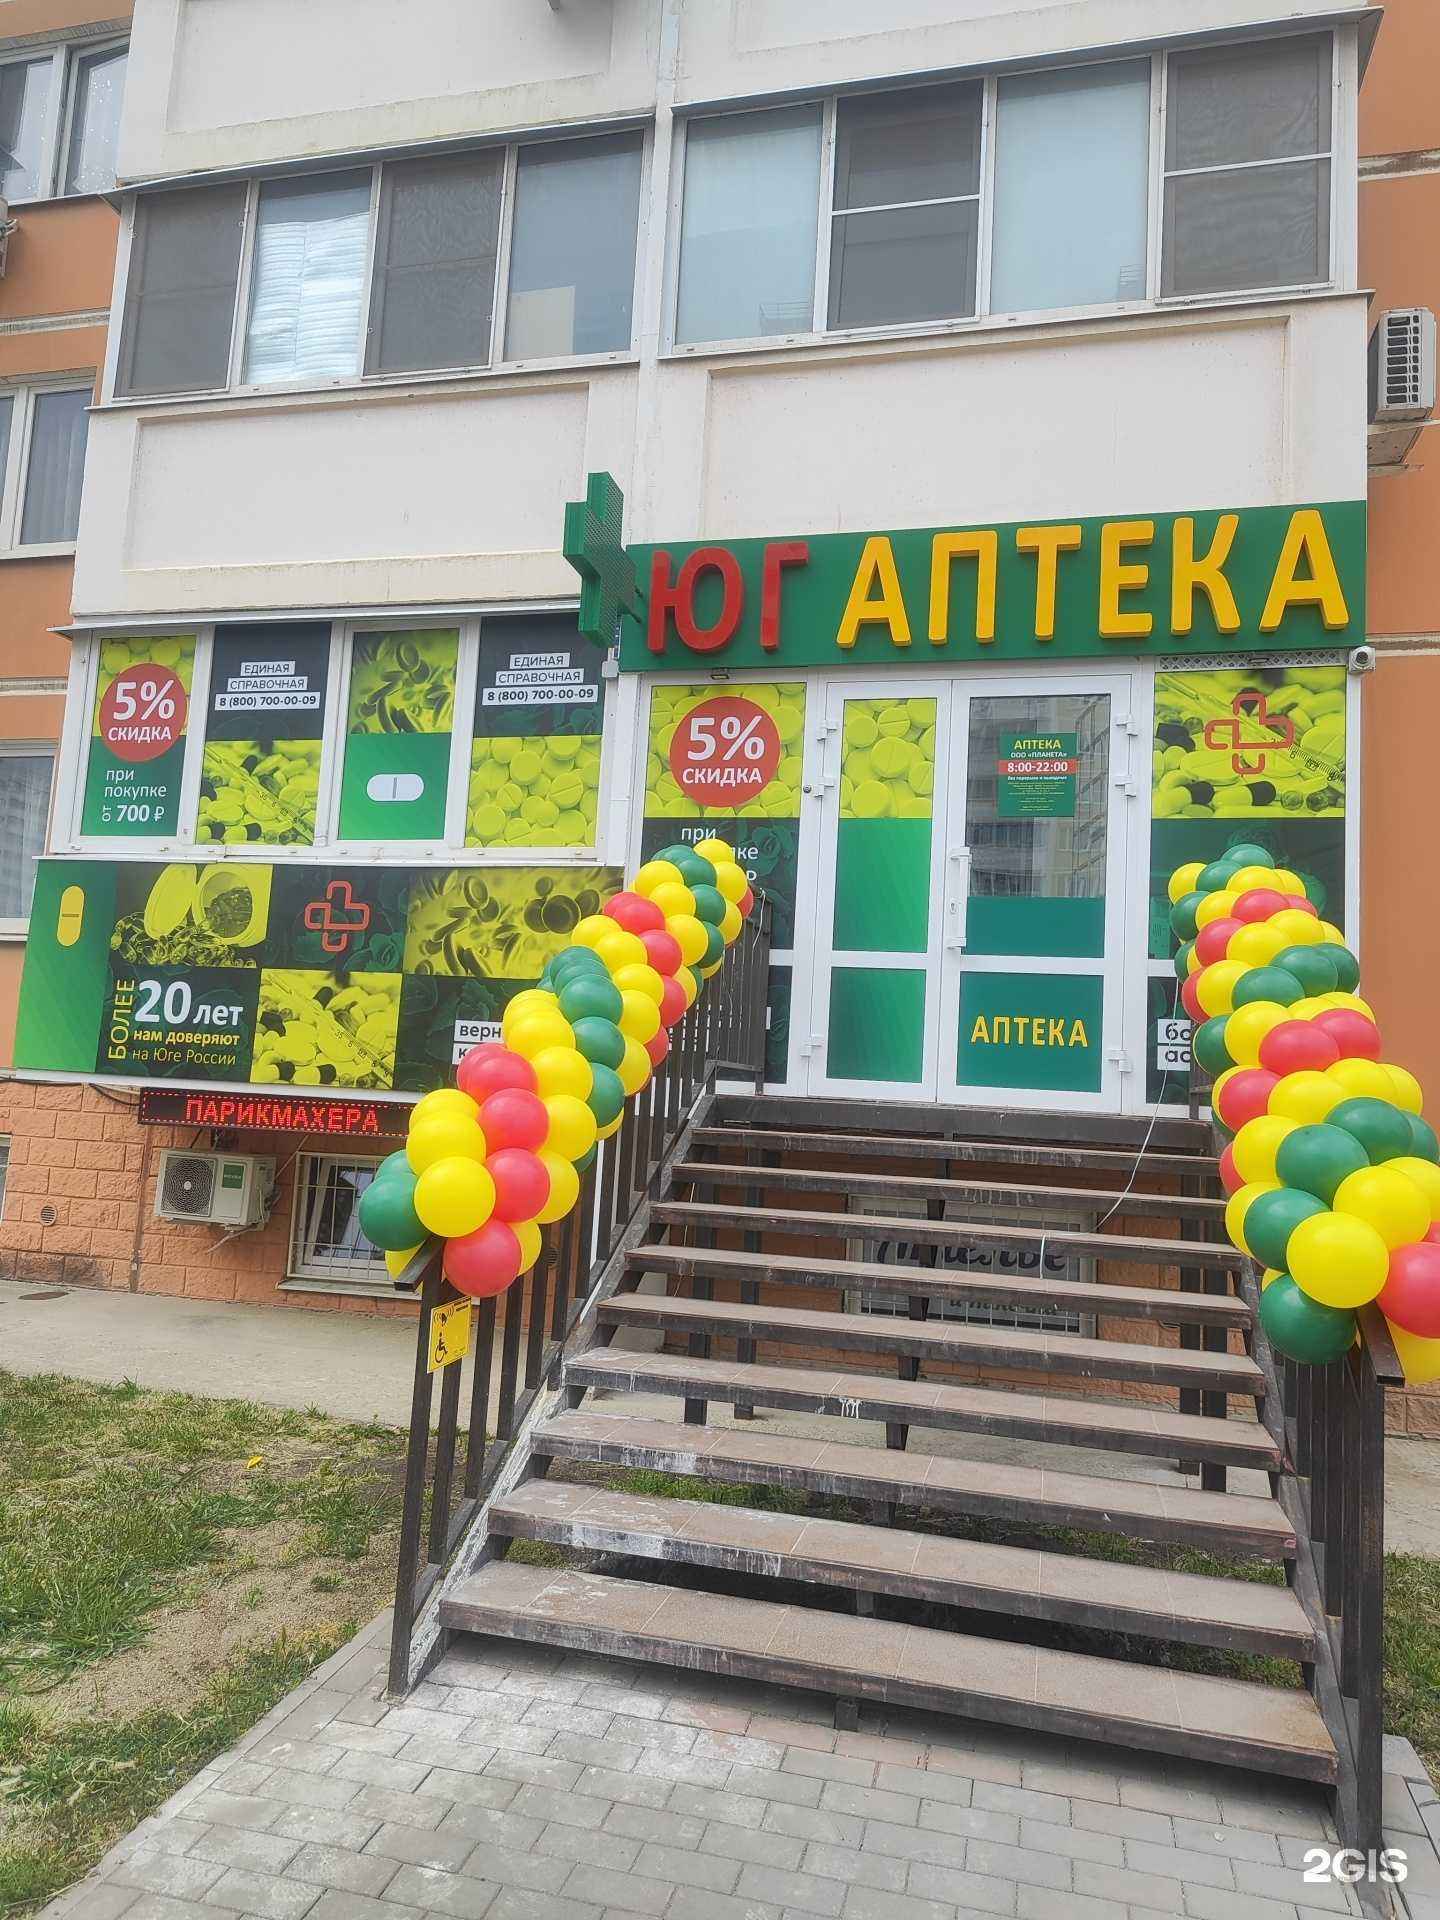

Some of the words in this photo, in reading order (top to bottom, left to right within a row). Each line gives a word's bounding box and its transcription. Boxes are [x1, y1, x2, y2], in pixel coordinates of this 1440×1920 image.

[647, 537, 809, 654] ЮГ
[836, 509, 1350, 648] АПТЕКА
[244, 664, 290, 674] ЕДИНАЯ
[514, 655, 564, 667] ЕДИНАЯ
[230, 679, 305, 690] СПРАВОЧНАЯ
[498, 671, 580, 683] СПРАВОЧНАЯ
[113, 679, 176, 721] 5%
[219, 698, 226, 706] 8
[229, 696, 257, 707] (800)
[260, 694, 316, 706] 700-00-09
[487, 691, 495, 701] 8
[498, 690, 529, 702] (800)
[532, 688, 594, 700] 700-00-09
[108, 726, 172, 742] СКИДКА
[687, 715, 765, 762] 5%
[1014, 739, 1061, 750] АПТЕКА
[1007, 761, 1068, 773] 8:00-22:00
[106, 769, 134, 784] при
[682, 767, 762, 786] СКИДКА
[104, 784, 167, 801] покупке
[116, 804, 150, 823] 700
[153, 806, 165, 822] ₽
[681, 827, 717, 844] при
[134, 979, 192, 1025] 20
[192, 1004, 244, 1026] лет
[108, 979, 135, 1060] БОЛЕЕ
[133, 1028, 163, 1043] нам
[165, 1030, 241, 1047] доверяют
[460, 1025, 502, 1041] верн
[970, 1014, 1089, 1048] АПТЕКА
[132, 1050, 149, 1061] на
[153, 1047, 182, 1063] Юге
[186, 1050, 237, 1065] России
[187, 1099, 379, 1132] ПАРИКМАХЕРА
